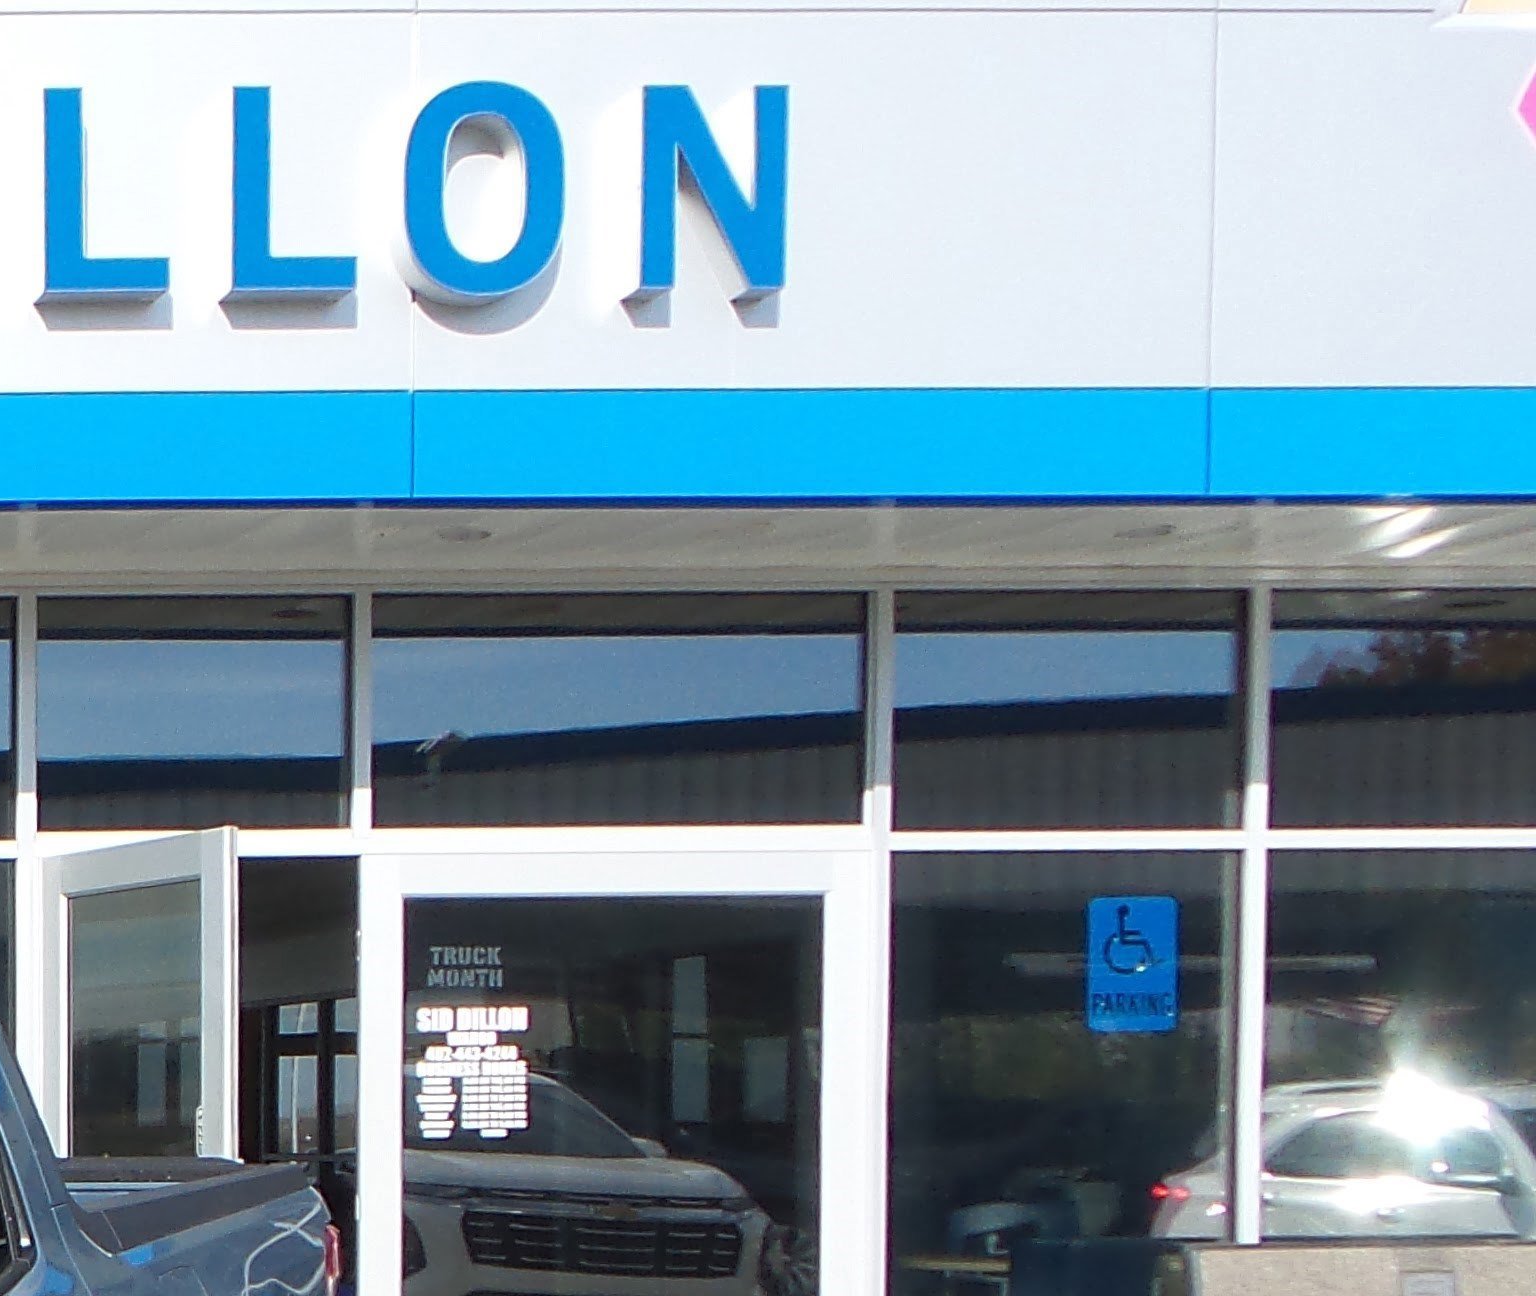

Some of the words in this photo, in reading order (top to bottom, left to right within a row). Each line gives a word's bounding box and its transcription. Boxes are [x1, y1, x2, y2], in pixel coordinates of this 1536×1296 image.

[429, 946, 503, 966] TRUCK
[427, 968, 503, 988] MONTH
[1091, 992, 1174, 1016] PARKING
[416, 1006, 454, 1032] SID
[456, 1006, 528, 1031] DILLON
